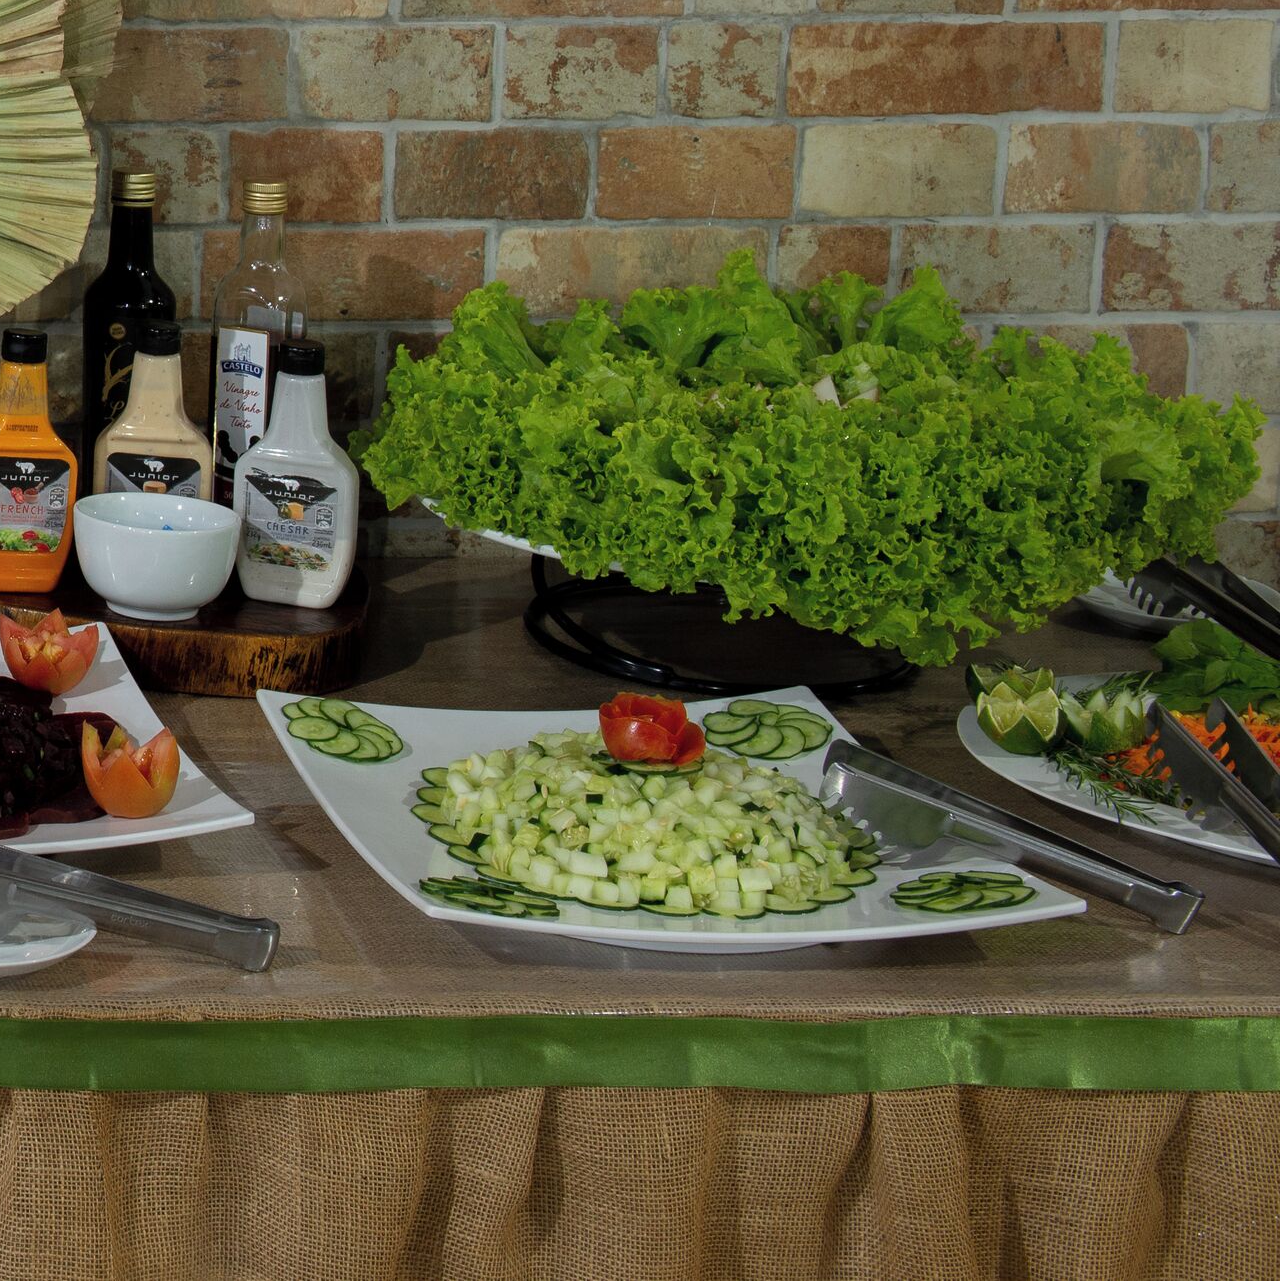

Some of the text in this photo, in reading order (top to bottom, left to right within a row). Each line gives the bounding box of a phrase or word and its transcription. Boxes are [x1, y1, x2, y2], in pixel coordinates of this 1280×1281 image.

[223, 362, 261, 375] CASTELO
[224, 380, 260, 399] Vinagre
[220, 398, 262, 415] de Vinho
[230, 415, 252, 430] Tinto
[129, 472, 179, 481] JUNIOR
[1, 504, 44, 515] FRENCH
[267, 522, 310, 535] CAESAR
